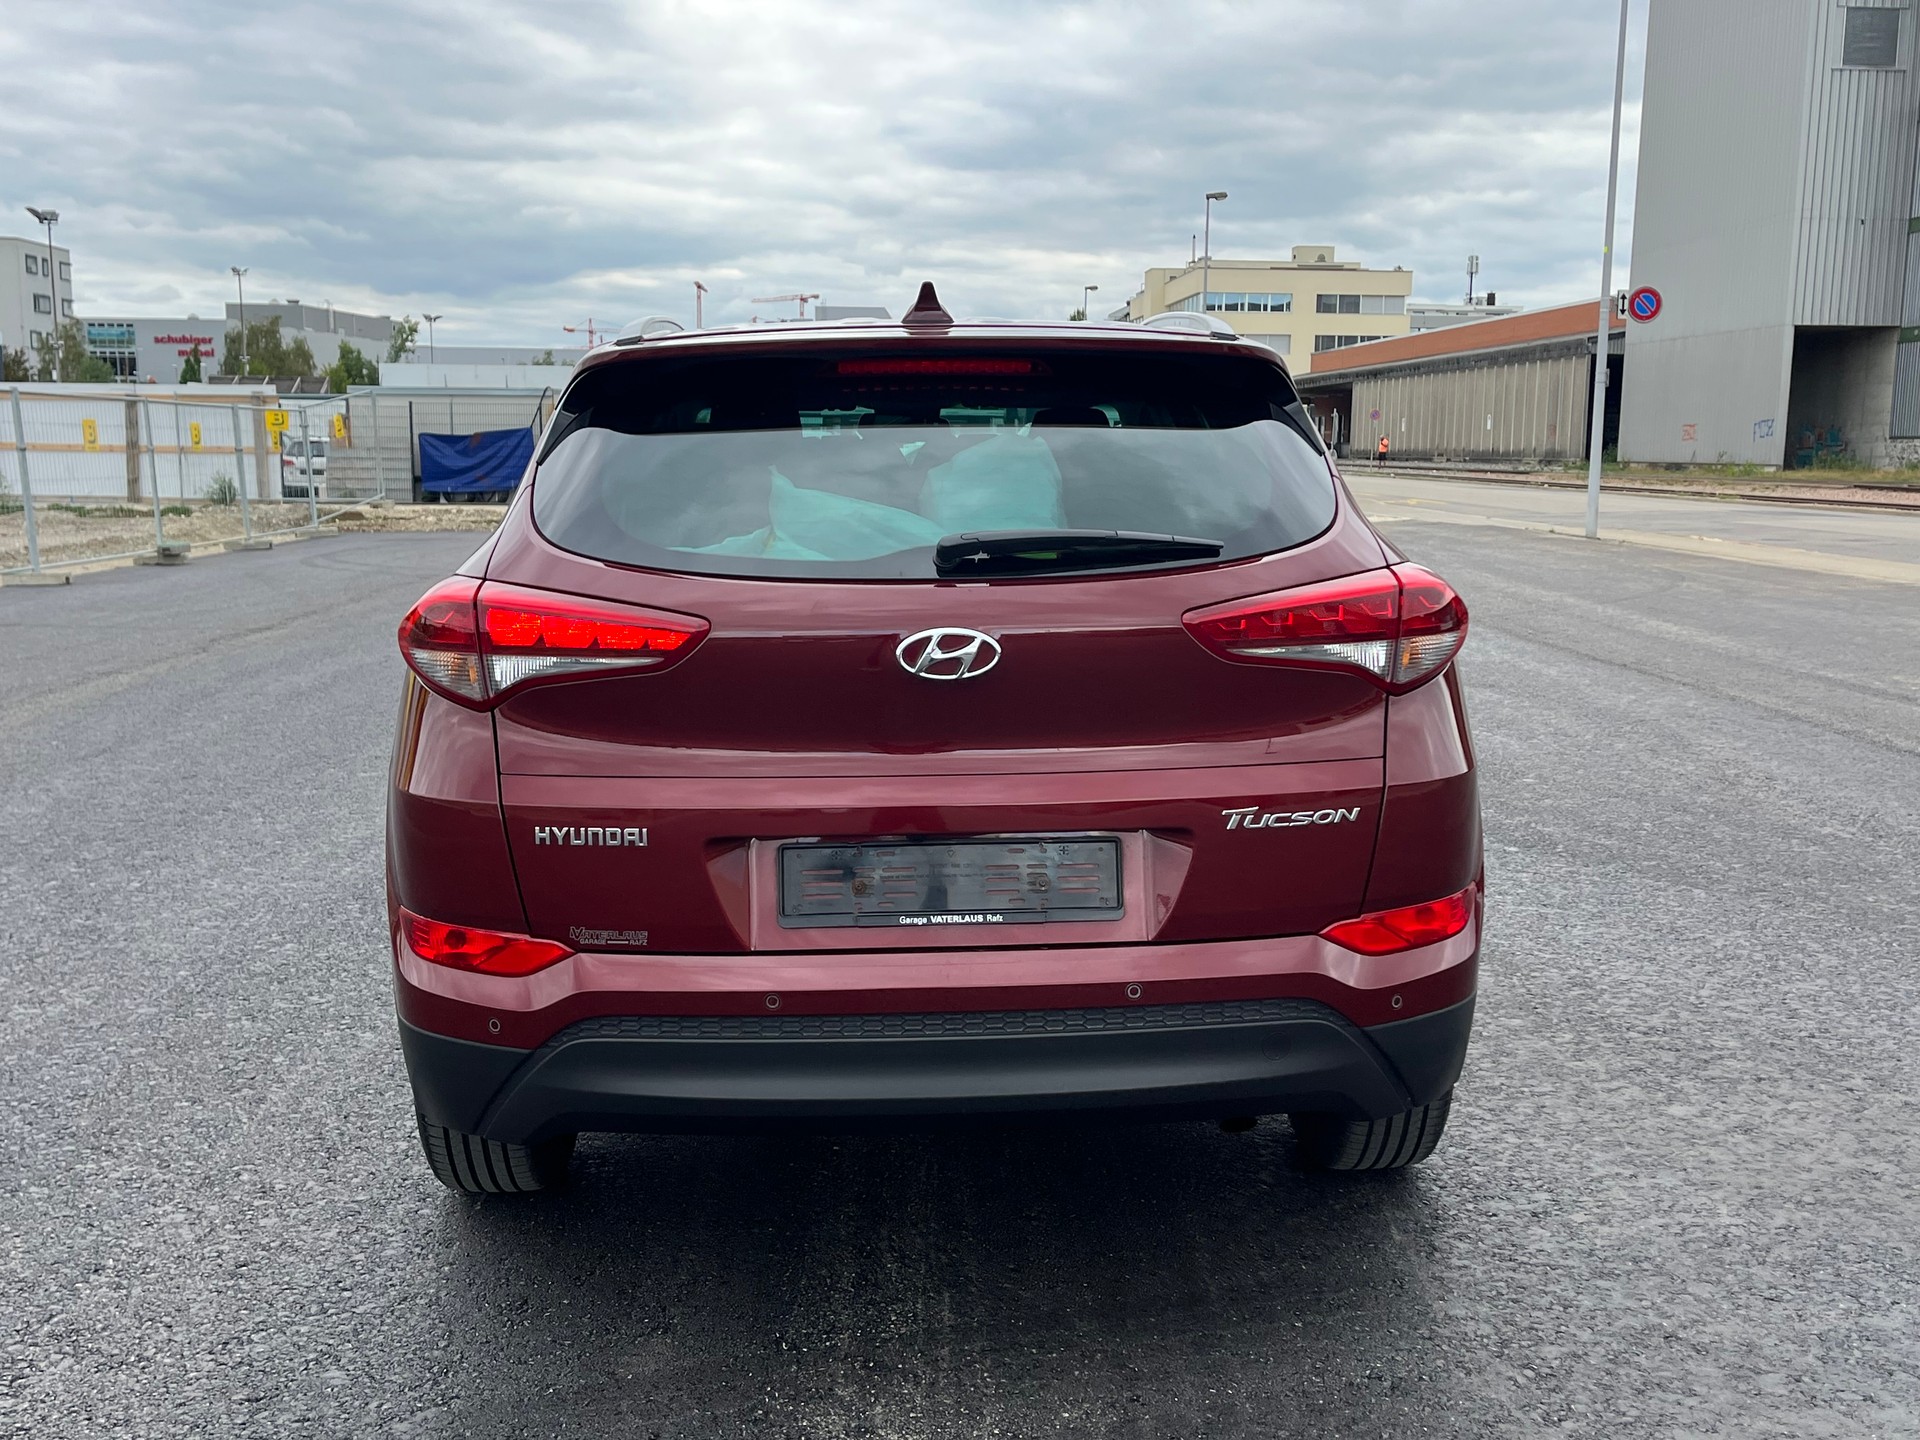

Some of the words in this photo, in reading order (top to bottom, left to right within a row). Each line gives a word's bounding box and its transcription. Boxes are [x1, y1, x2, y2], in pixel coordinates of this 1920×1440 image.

[154, 334, 213, 345] schubiger
[178, 348, 215, 357] mbel
[1221, 806, 1361, 830] TUCSON
[534, 826, 648, 846] HYUNDAI
[899, 915, 928, 925] Garage
[930, 914, 984, 923] VATERLAUS
[986, 914, 1004, 922] Rafz
[569, 926, 648, 941] VATERLAUS
